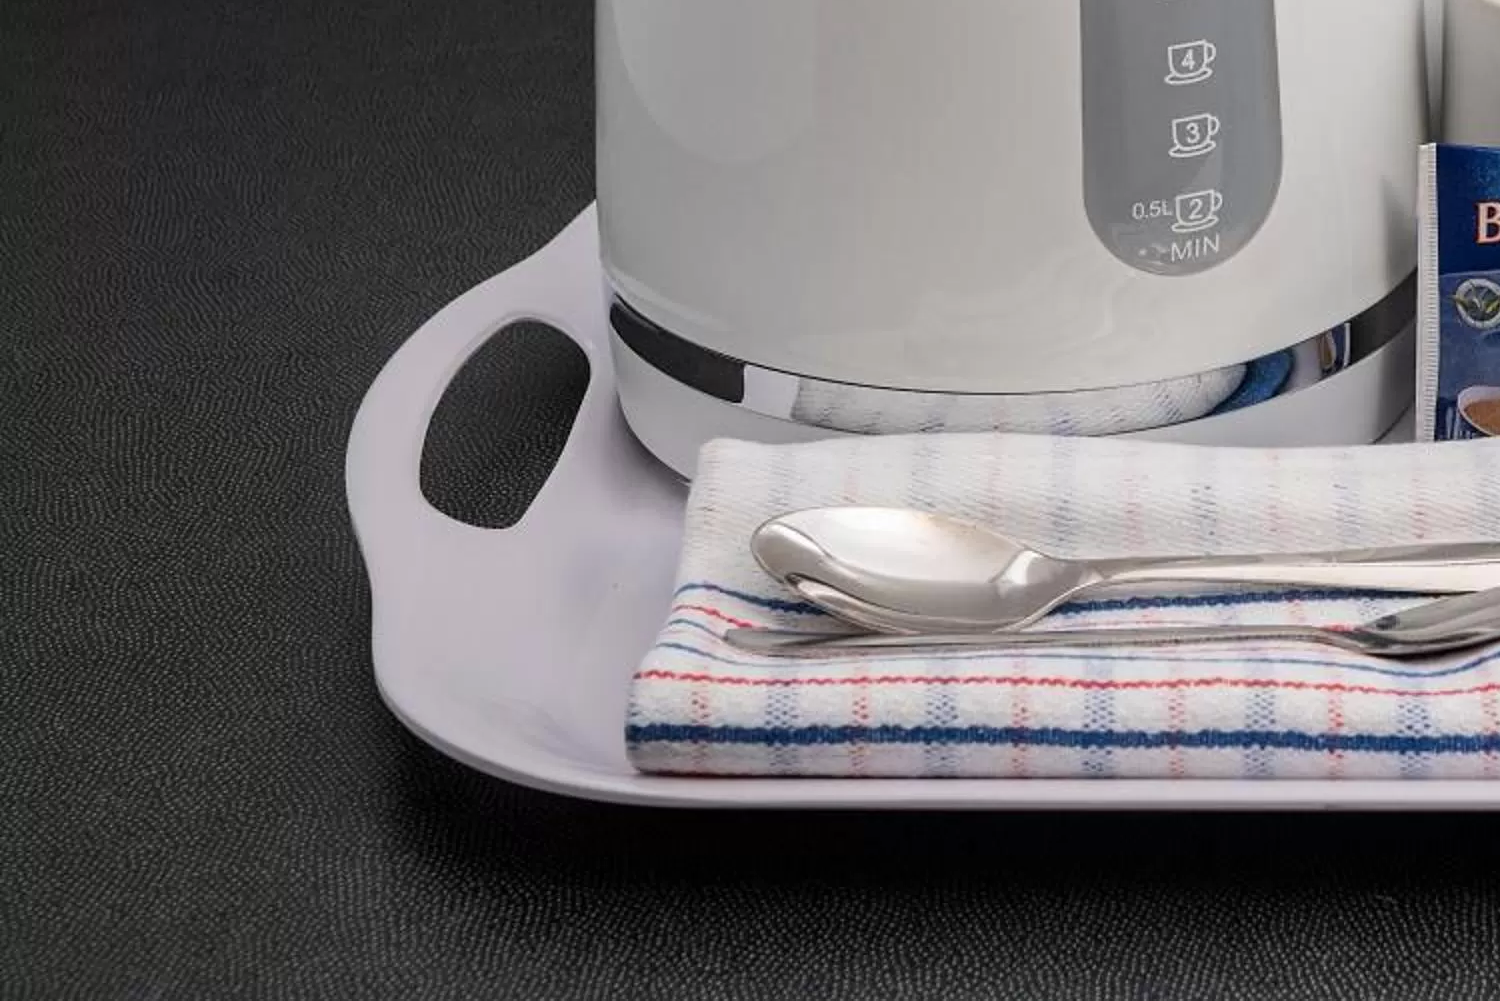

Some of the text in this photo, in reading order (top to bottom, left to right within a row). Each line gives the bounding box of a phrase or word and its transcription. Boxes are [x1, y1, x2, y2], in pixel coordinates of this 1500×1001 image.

[1181, 49, 1195, 70] 4
[1185, 123, 1200, 144] 3
[1132, 199, 1173, 220] 0.5L
[1188, 198, 1203, 220] 2
[1171, 233, 1220, 262] MIN
